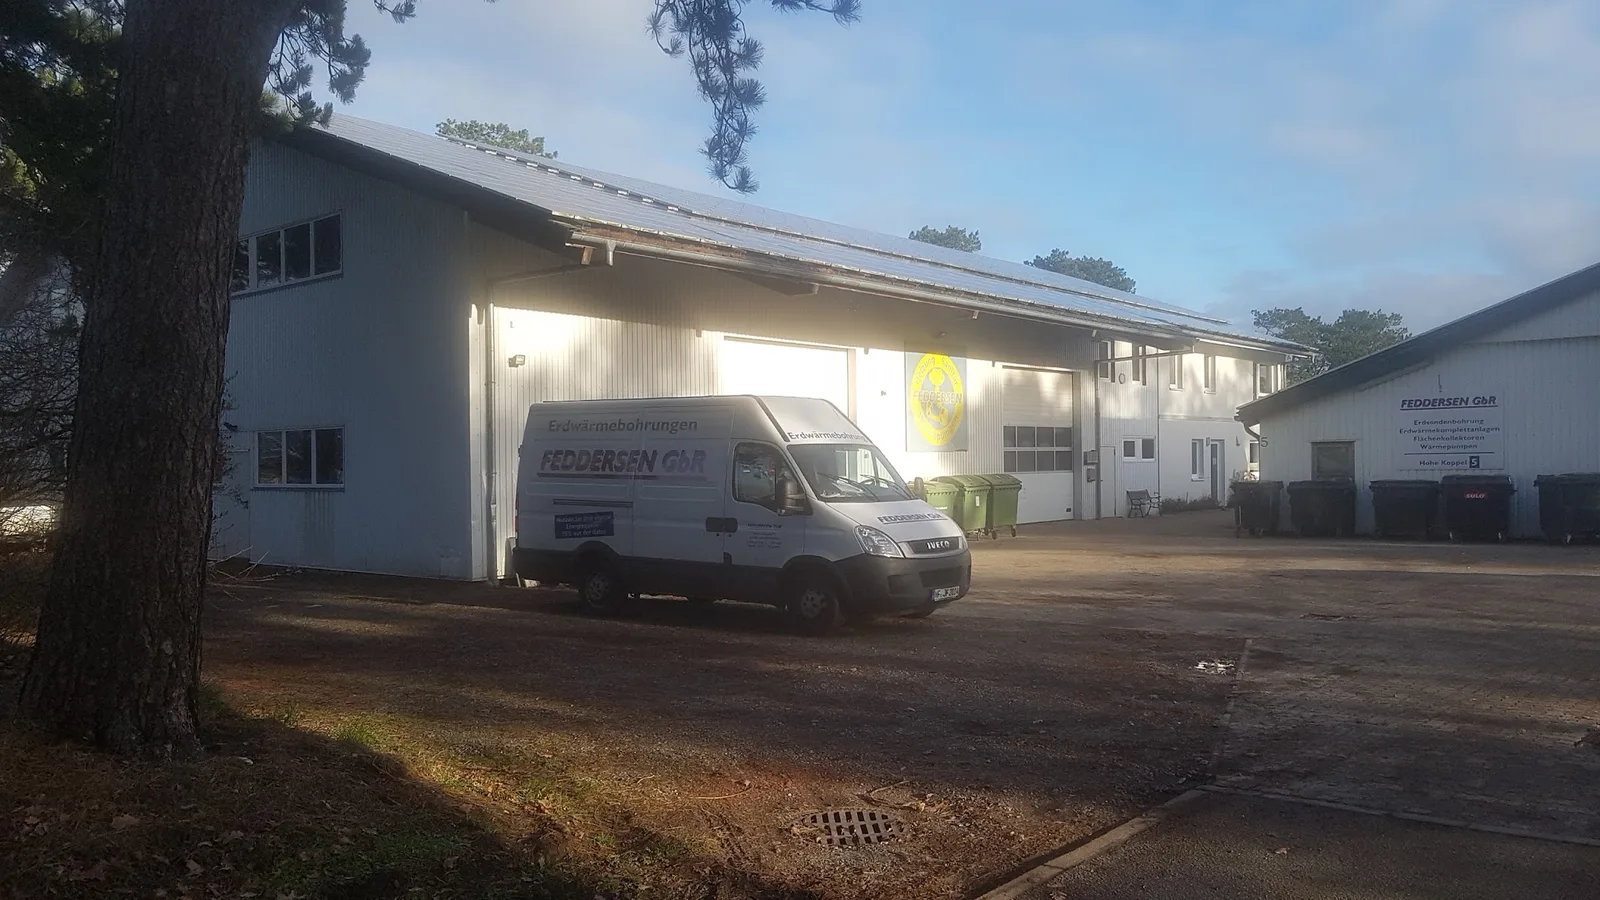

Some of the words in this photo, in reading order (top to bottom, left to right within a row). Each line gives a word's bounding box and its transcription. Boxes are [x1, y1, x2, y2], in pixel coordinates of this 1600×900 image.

[913, 390, 963, 404] FEDDERSEN
[1401, 397, 1469, 408] FEDDERSEN
[1472, 396, 1497, 405] GbR
[549, 419, 698, 434] Erdwärmebohrungen
[1260, 436, 1269, 448] 5
[540, 450, 658, 473] FEDDERSEN
[662, 450, 707, 473] GbR
[1470, 457, 1479, 467] 5
[876, 513, 928, 523] FEDDERSEN
[927, 541, 950, 550] IVECO
